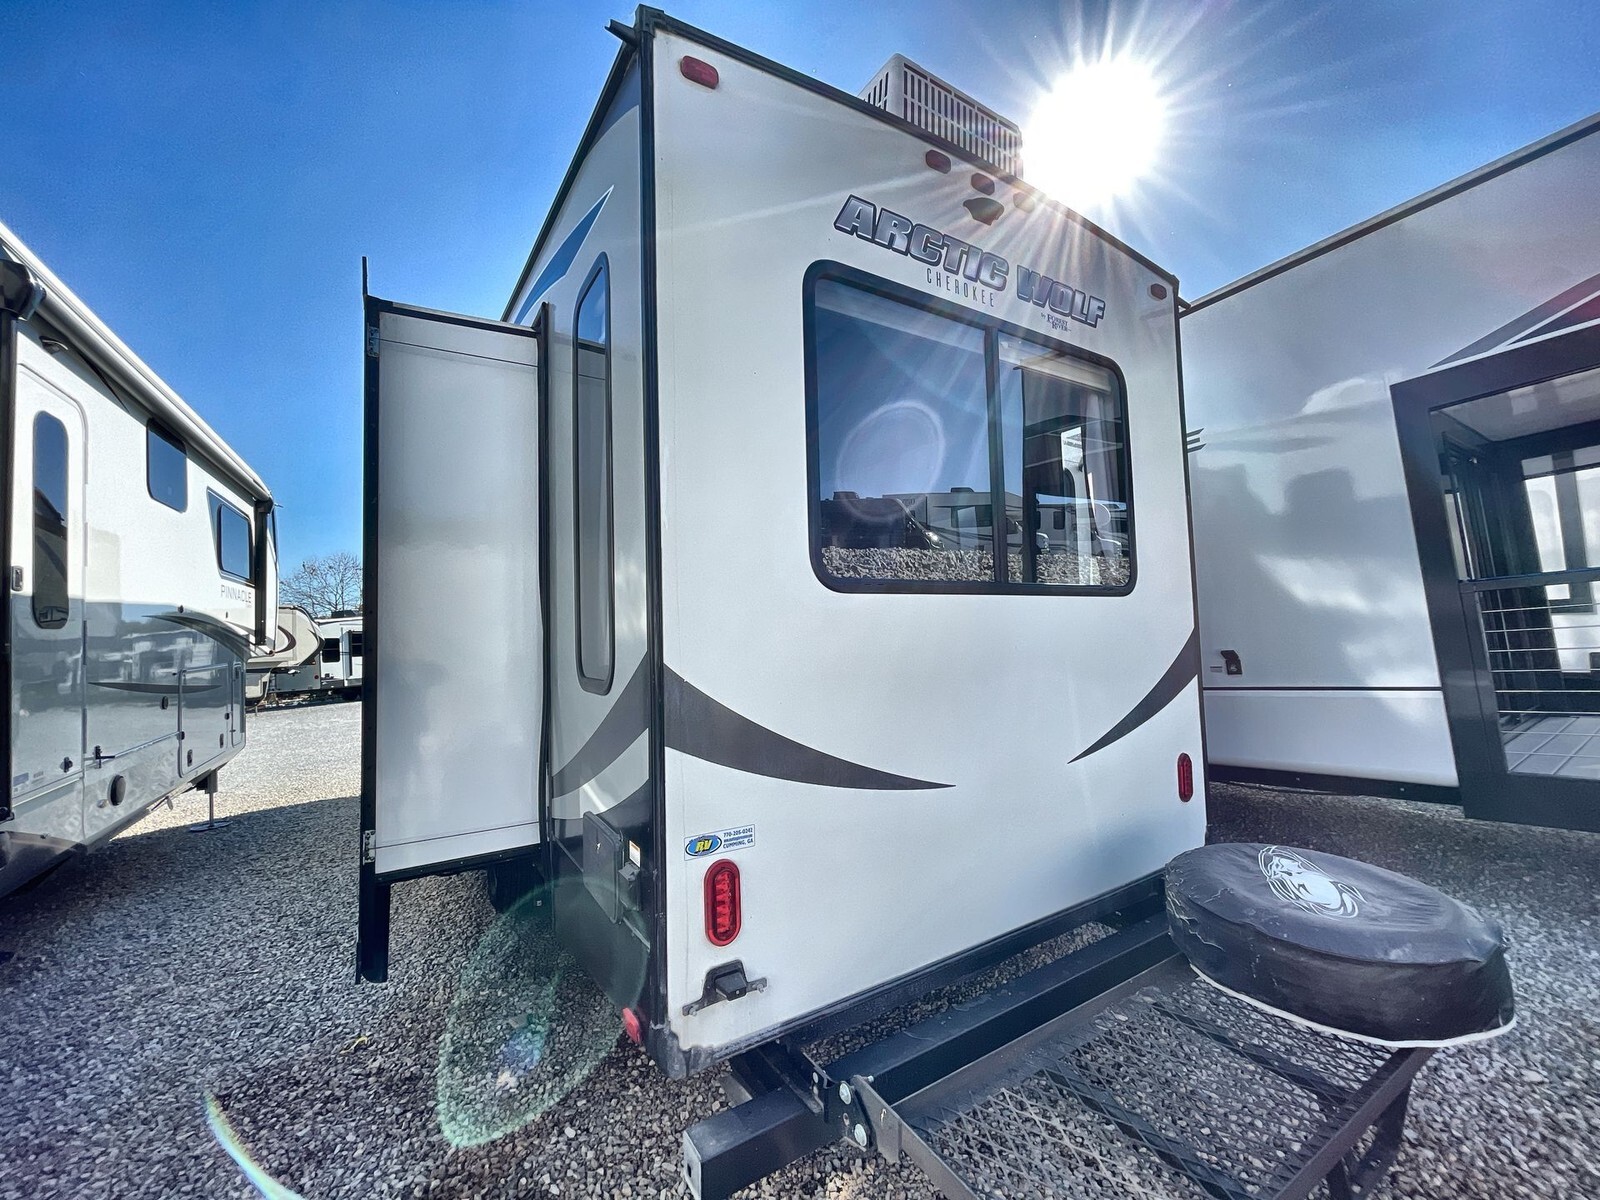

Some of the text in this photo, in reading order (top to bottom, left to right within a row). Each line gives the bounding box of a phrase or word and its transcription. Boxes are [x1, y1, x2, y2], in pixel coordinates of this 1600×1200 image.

[834, 194, 1105, 328] ARCTIC WOLF
[926, 267, 995, 308] CHEROKEE
[221, 585, 251, 603] PINNACLE
[695, 839, 713, 853] RV
